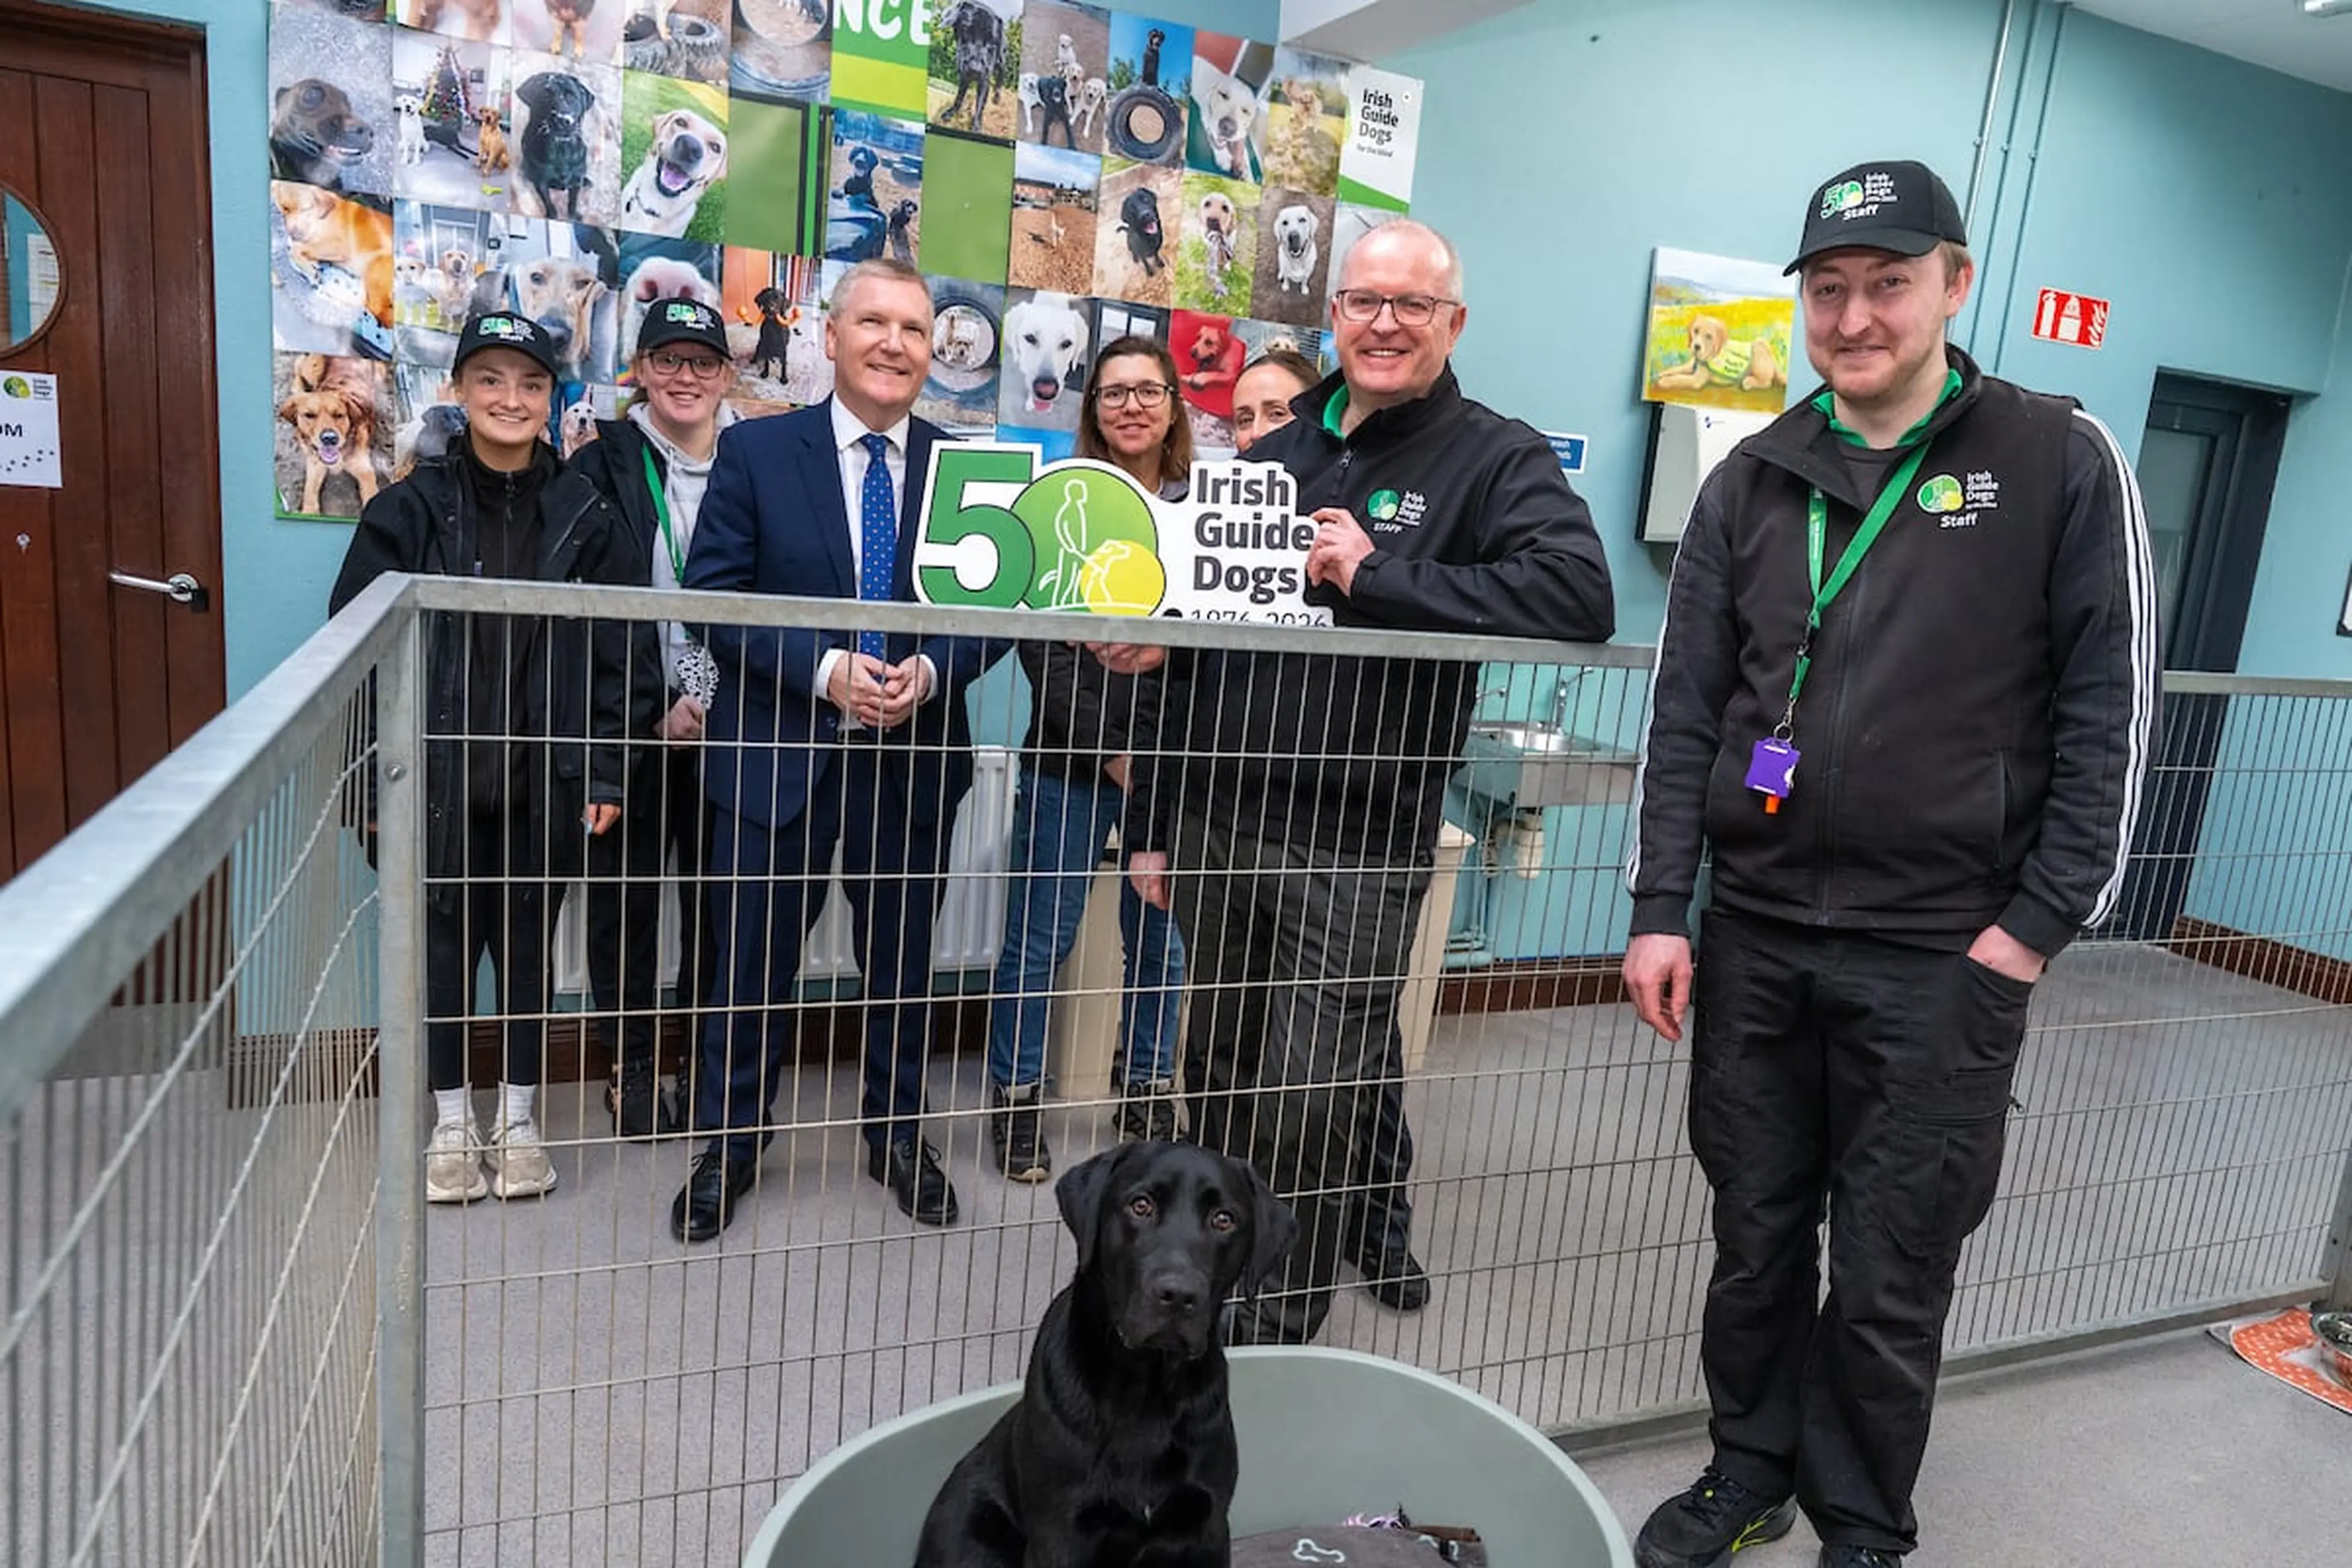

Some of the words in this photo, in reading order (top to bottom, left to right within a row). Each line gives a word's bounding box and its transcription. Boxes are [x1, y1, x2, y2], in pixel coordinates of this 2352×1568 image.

[1363, 88, 1393, 108] Irish
[1361, 105, 1398, 127] Guide
[1359, 122, 1392, 145] Dogs
[1842, 203, 1879, 221] Staff
[1197, 467, 1289, 507] Irish
[1940, 511, 1978, 528] Staff
[1194, 511, 1316, 552] Guide
[1193, 554, 1298, 605] Dogs
